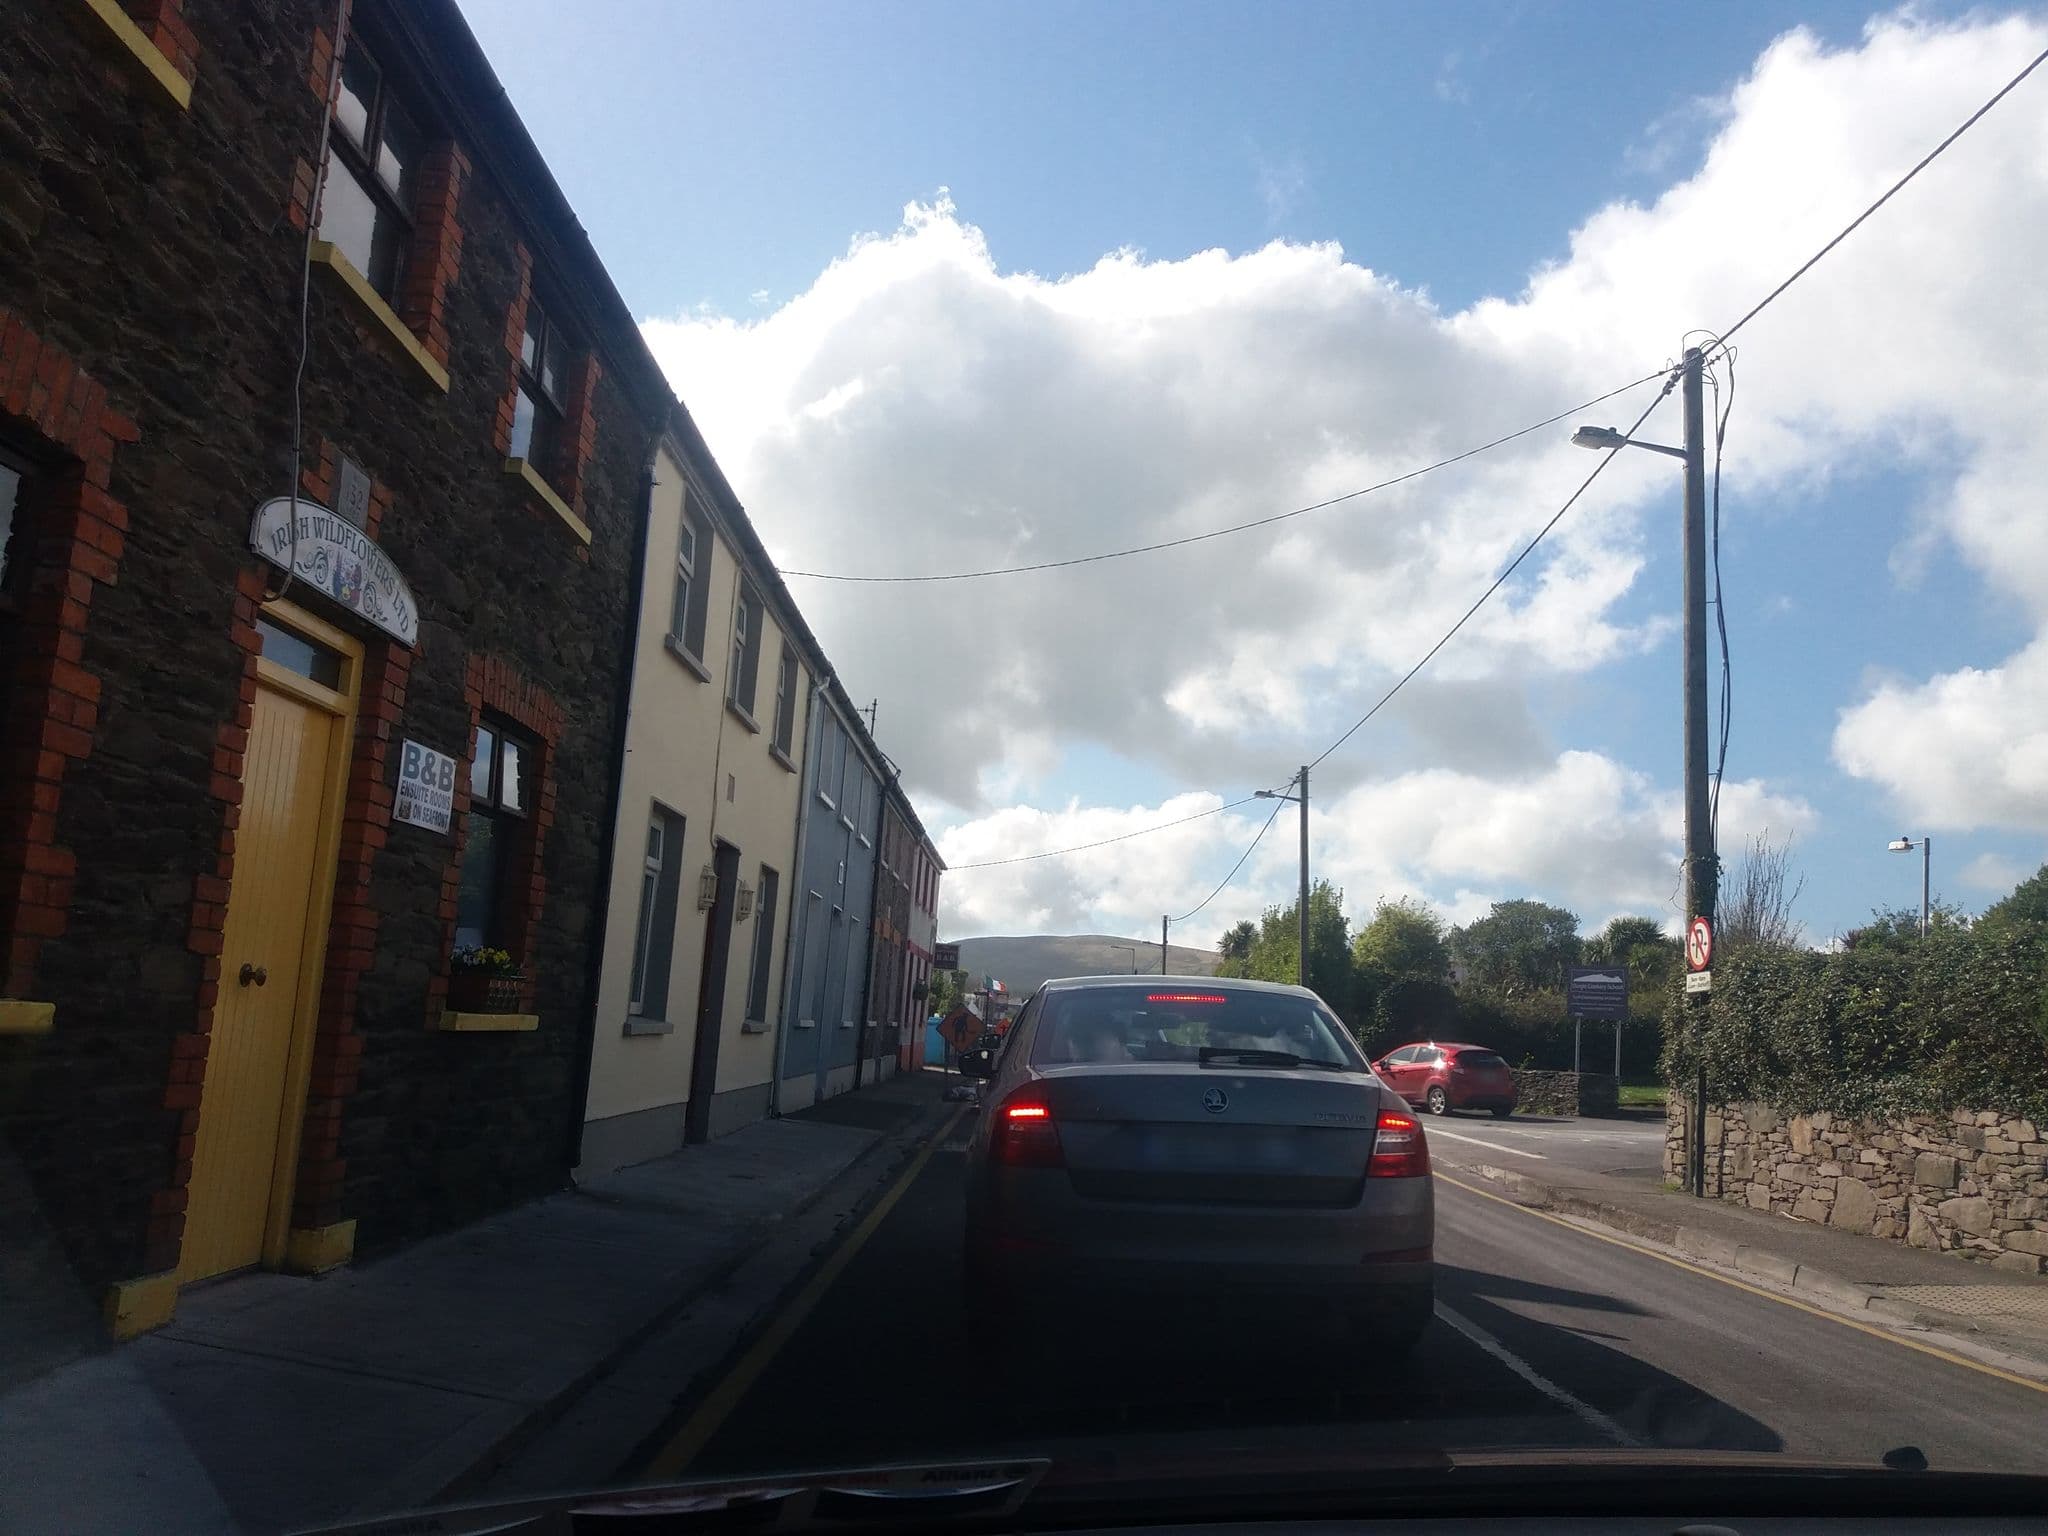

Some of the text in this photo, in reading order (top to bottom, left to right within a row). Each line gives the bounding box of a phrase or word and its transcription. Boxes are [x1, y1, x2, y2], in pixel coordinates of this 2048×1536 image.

[270, 516, 410, 633] IRISH WILDFLOWERS LTD
[403, 744, 453, 792] B&B
[401, 780, 449, 811] ENSUITE ROOMS
[412, 802, 448, 829] ON SEAFRONT
